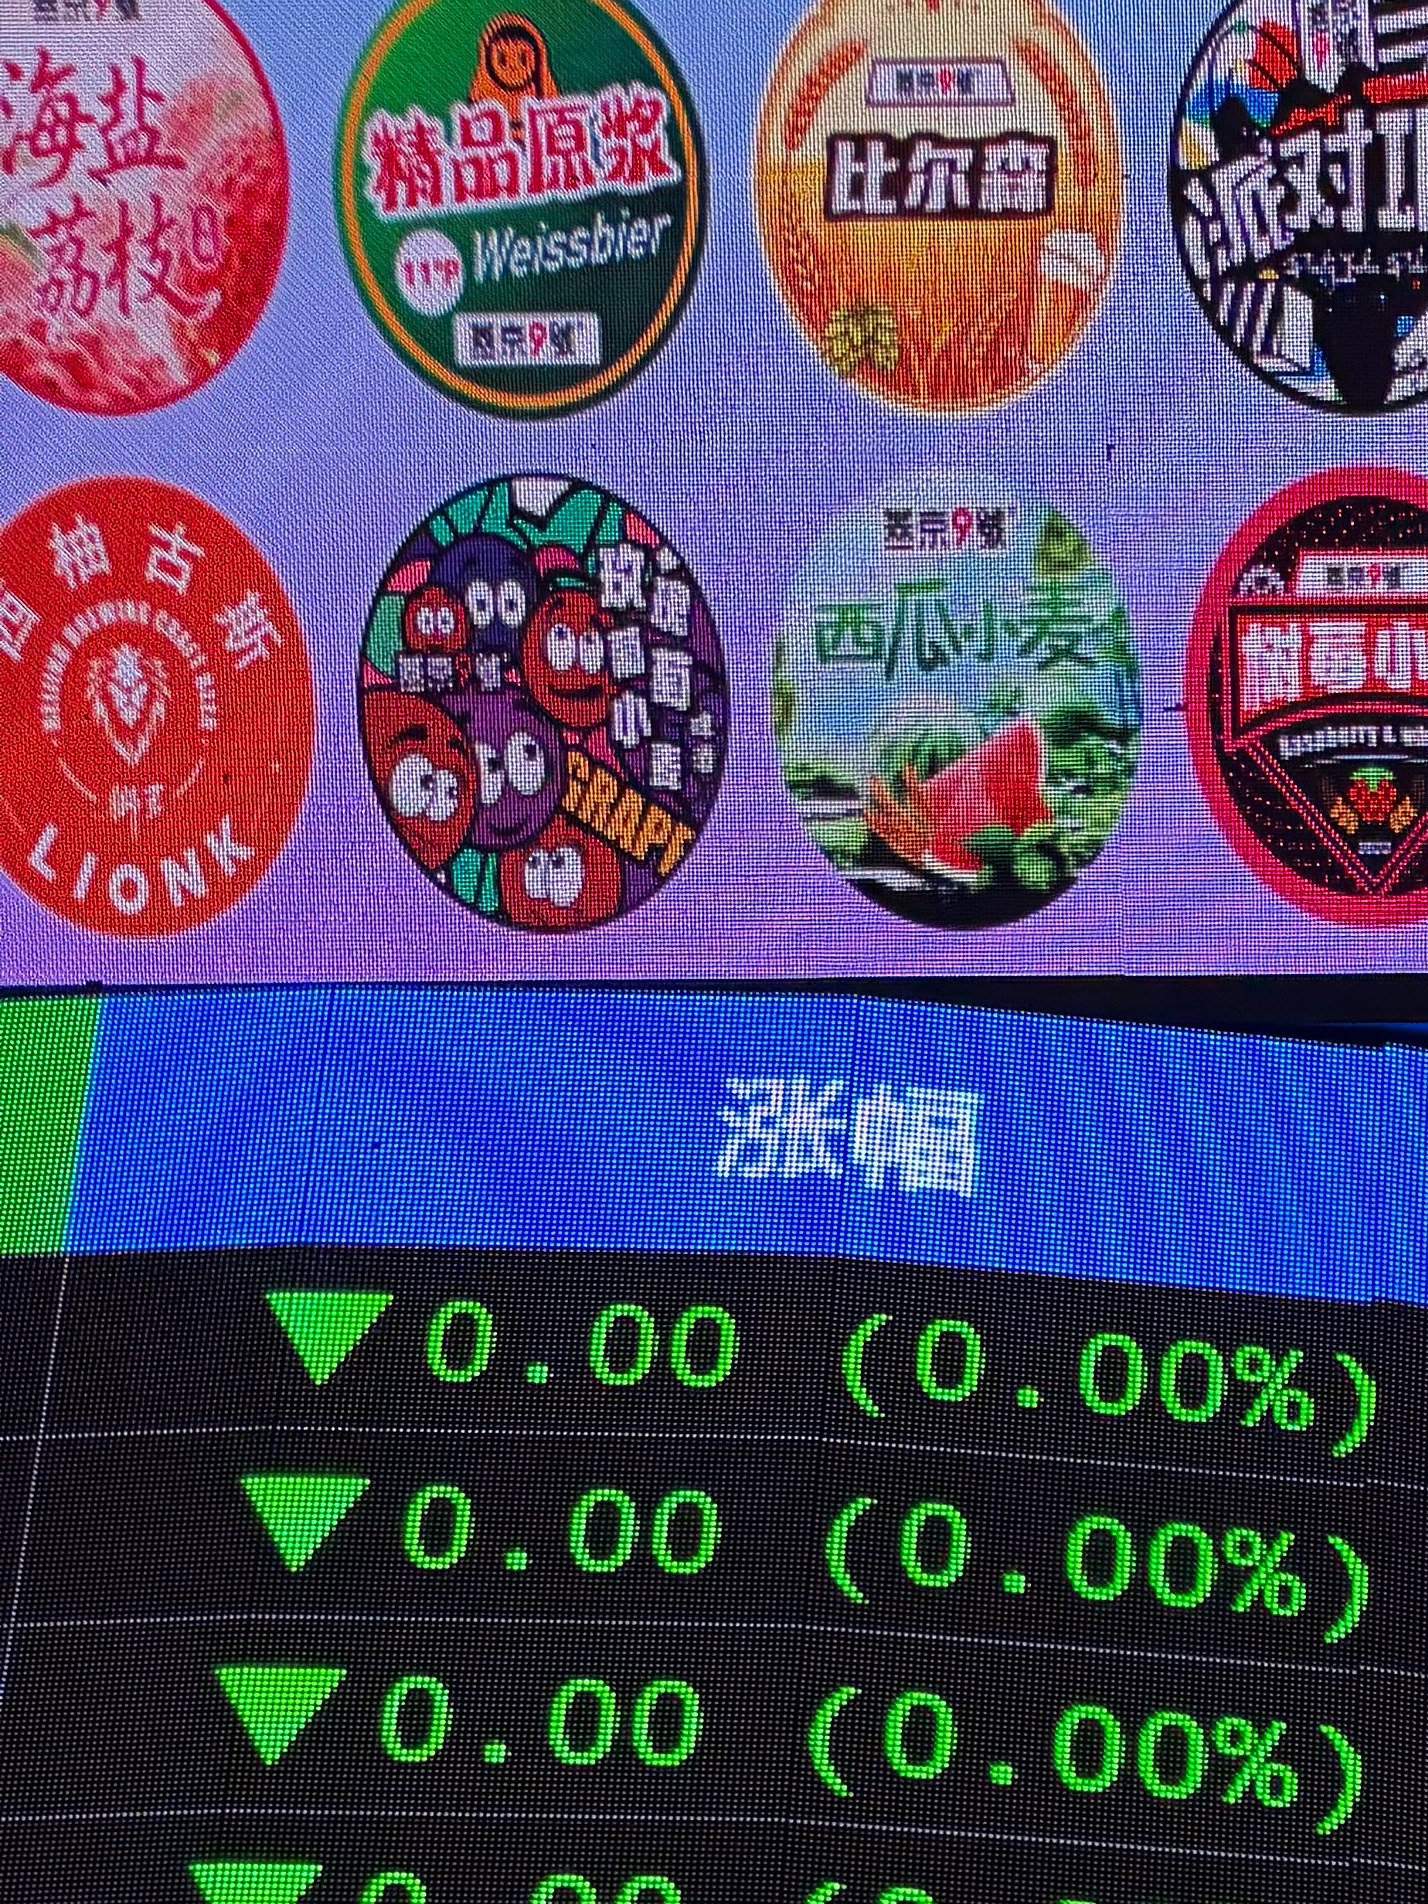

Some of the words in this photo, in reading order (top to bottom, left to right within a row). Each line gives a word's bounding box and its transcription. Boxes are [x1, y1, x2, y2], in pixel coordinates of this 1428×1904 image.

[2, 50, 186, 184] 海盐
[369, 94, 674, 211] 精品原浆
[831, 136, 1055, 217] 比尔森
[35, 199, 222, 320] 荔枝
[471, 210, 671, 283] Weissbier
[464, 321, 579, 361] 燕京9號
[884, 508, 1008, 549] 燕京9號
[816, 578, 1113, 680] 西瓜小麦
[27, 816, 255, 915] LIONK
[715, 1077, 984, 1197] 涨幅
[426, 1301, 739, 1388] 0.00
[842, 1313, 1377, 1457] (0.00%)
[403, 1484, 722, 1575] 0.00
[825, 1497, 1370, 1644] (0.00%)
[380, 1675, 703, 1767] 0.00
[808, 1686, 1363, 1835] (0.00%)
